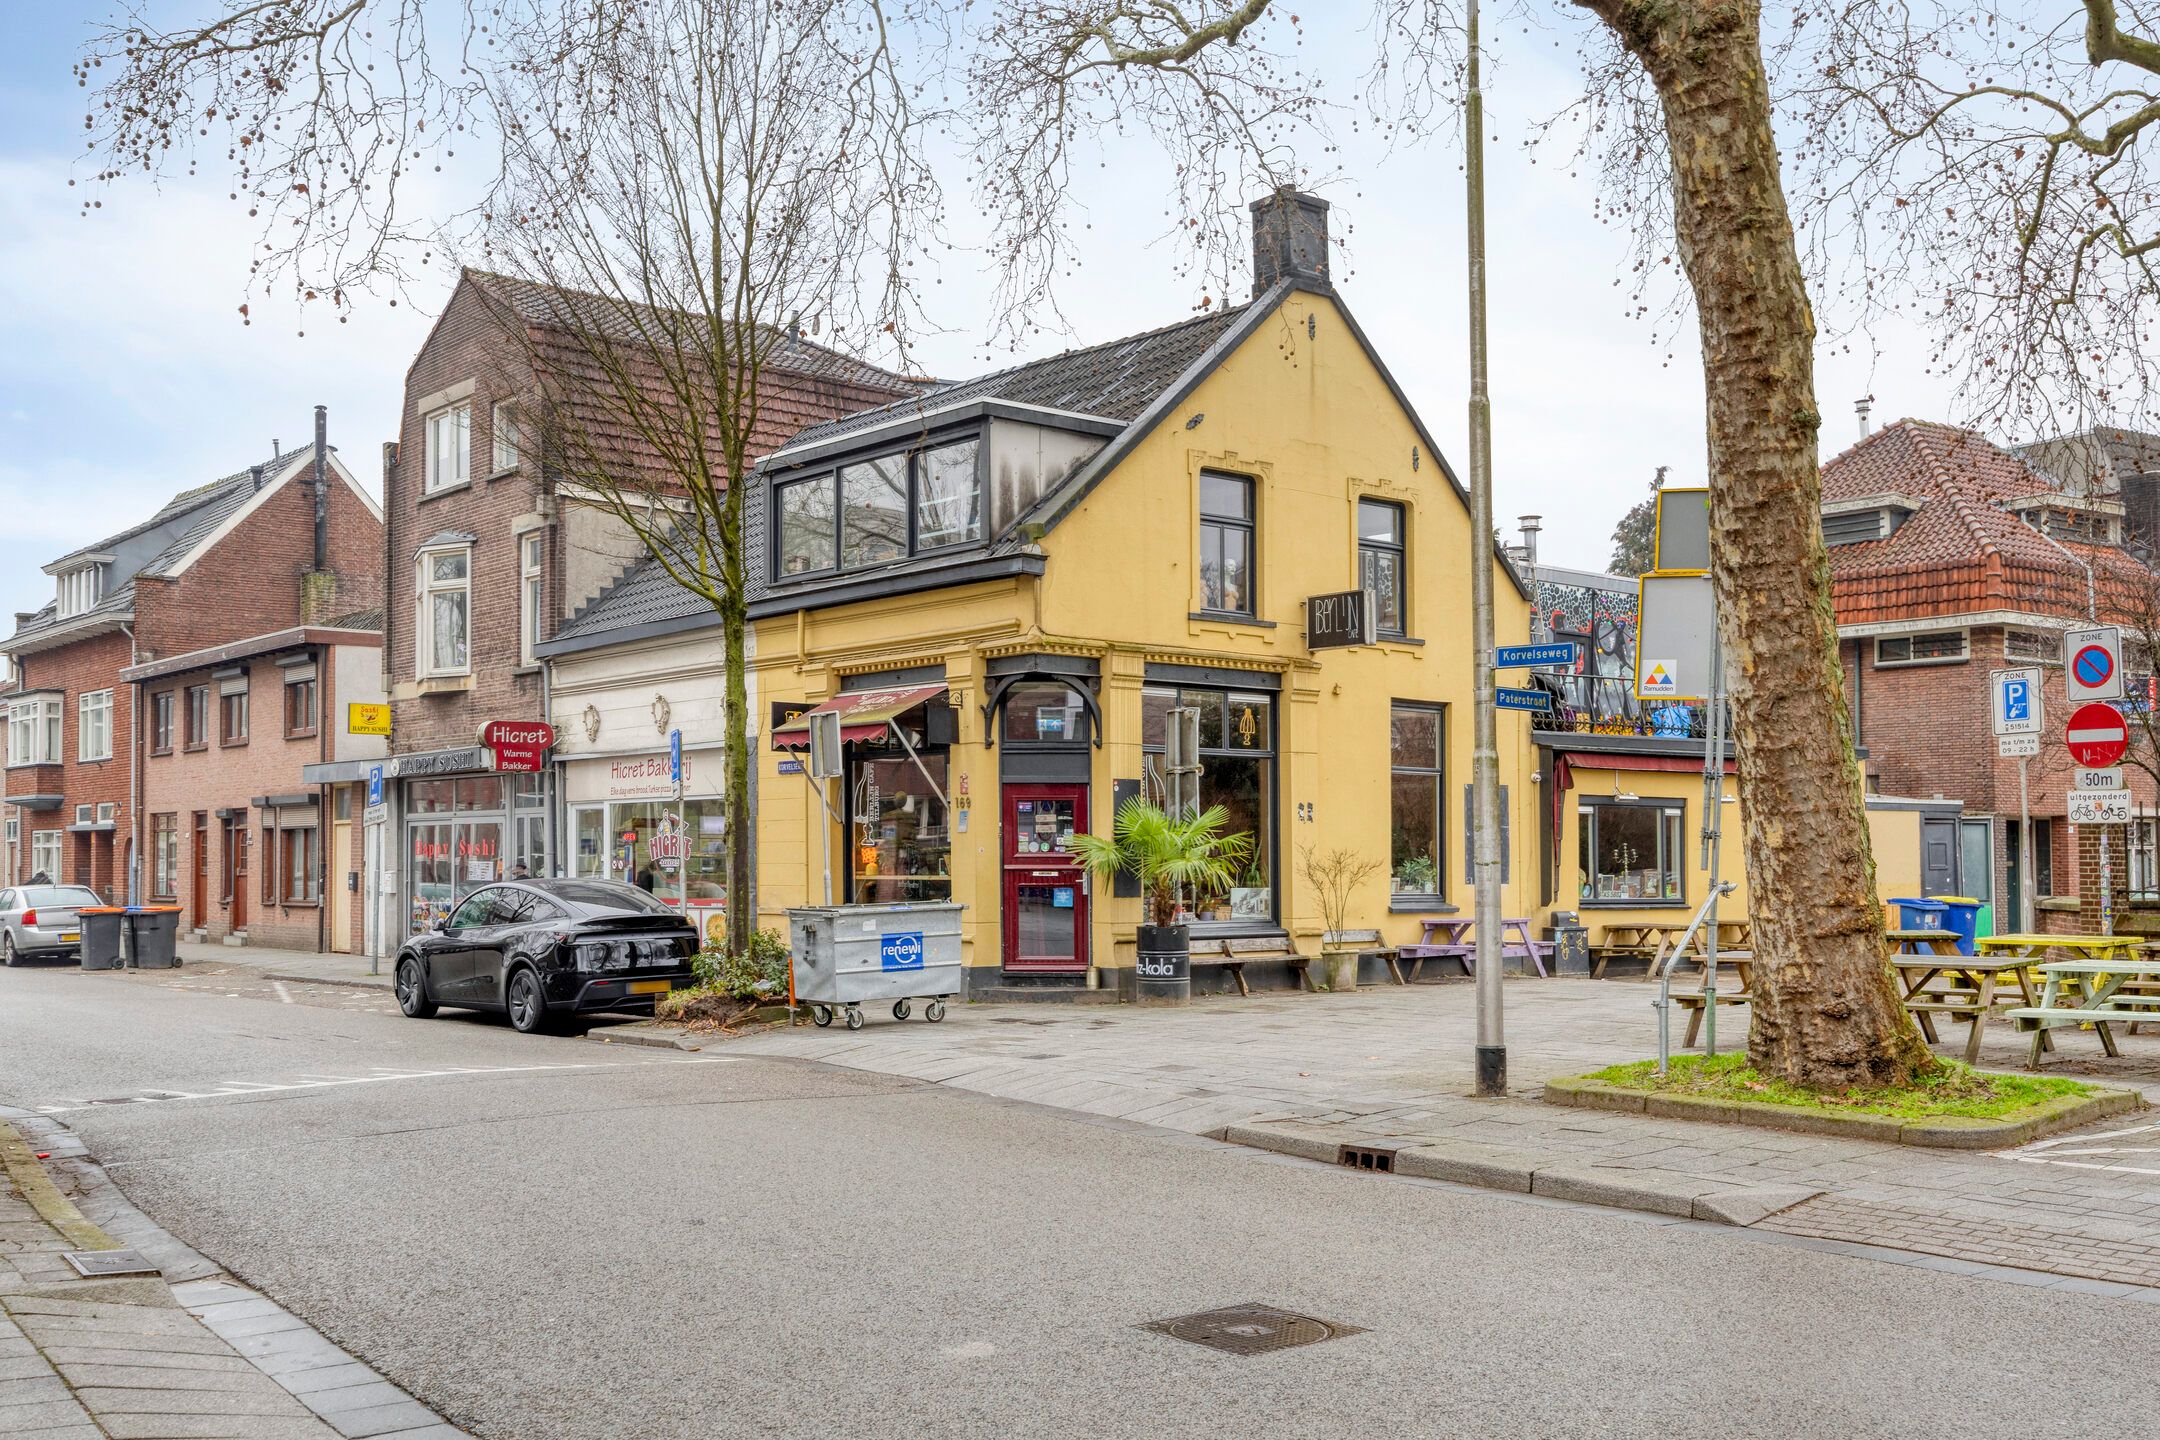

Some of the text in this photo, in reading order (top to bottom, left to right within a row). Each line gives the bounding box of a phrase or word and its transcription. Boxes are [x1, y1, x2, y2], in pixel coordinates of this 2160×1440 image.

[2080, 633, 2103, 641] ZONE
[1503, 649, 1568, 663] Korvelseweg
[2004, 672, 2026, 680] ZONE
[1500, 693, 1547, 707] Paterstraat
[2008, 684, 2023, 705] P
[493, 726, 548, 744] Hicret
[503, 749, 533, 758] Warme
[400, 751, 474, 775] HAPPY SUSHI
[502, 761, 532, 770] Bakker
[611, 757, 692, 781] Hicret Bakkrij
[2085, 773, 2113, 786] 50m
[955, 796, 971, 809] 169
[2069, 792, 2128, 802] uitgezonderd
[415, 838, 495, 864] Happy Sushi
[882, 942, 921, 956] renewi
